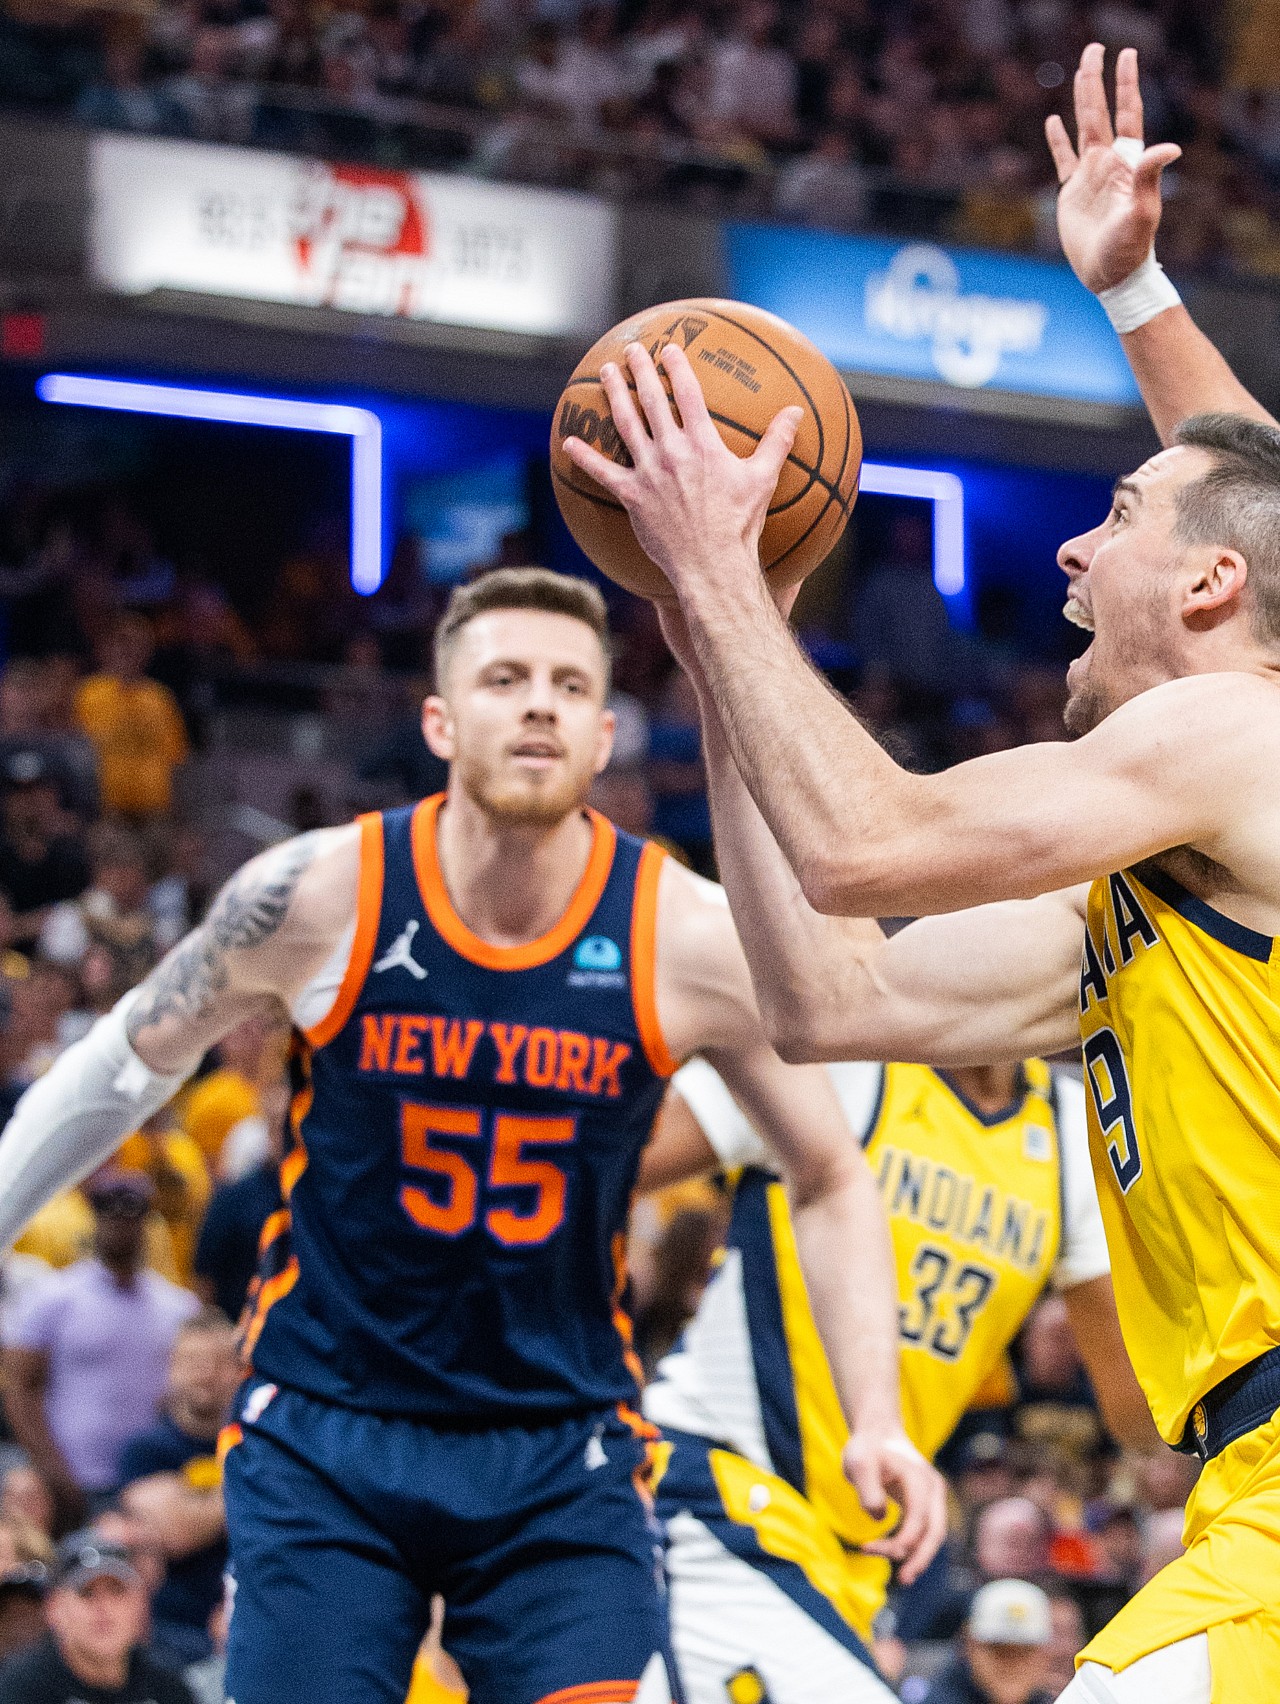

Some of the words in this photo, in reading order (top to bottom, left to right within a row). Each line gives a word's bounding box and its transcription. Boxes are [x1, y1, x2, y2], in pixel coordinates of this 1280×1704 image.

[359, 1013, 485, 1079] NEW
[489, 1021, 633, 1097] YORK
[1082, 1025, 1142, 1195] 9
[400, 1100, 578, 1245] 55
[899, 1244, 995, 1363] 33
